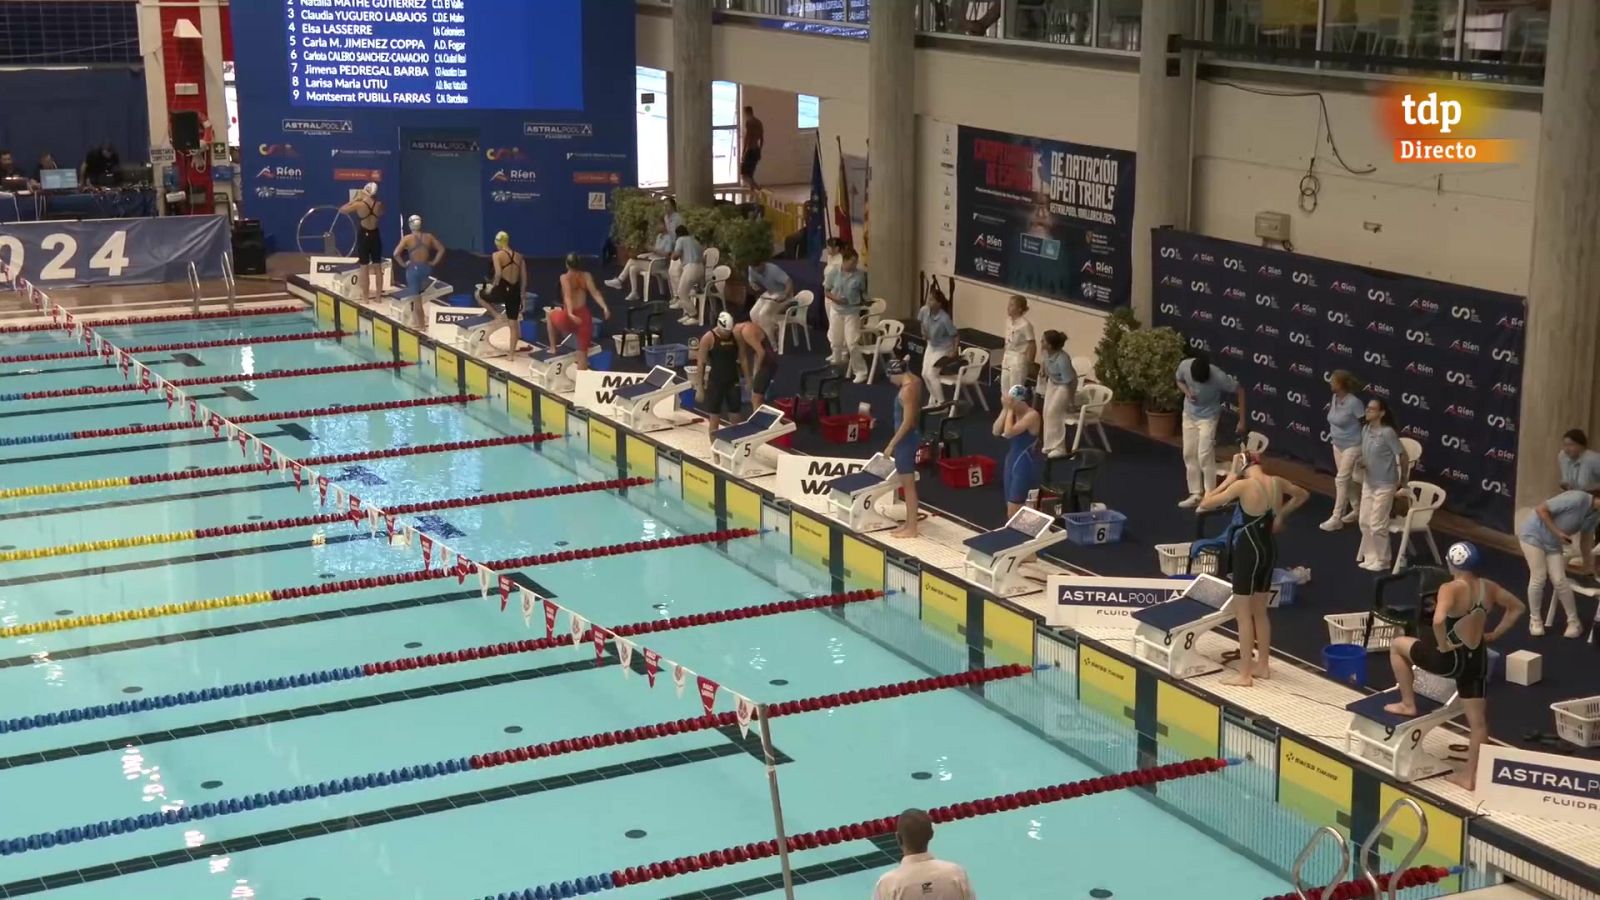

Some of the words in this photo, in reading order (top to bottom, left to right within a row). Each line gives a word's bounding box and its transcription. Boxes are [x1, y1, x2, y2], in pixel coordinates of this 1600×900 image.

[372, 0, 427, 8] GUTIERREZ
[288, 8, 295, 19] 3
[301, 10, 334, 21] Claudia
[335, 11, 383, 22] YUGUERO
[385, 12, 427, 22] LABAJOS
[288, 22, 296, 32] 4
[302, 23, 321, 34] Elsa
[323, 24, 373, 35] LASSERRE
[289, 35, 297, 46] 5
[302, 37, 327, 48] Carla
[329, 38, 342, 48] M.
[344, 39, 388, 49] JIMENEZ
[390, 39, 426, 50] COPPA
[290, 49, 298, 60] 6
[303, 50, 327, 61] Carlota
[328, 51, 355, 62] CALERO
[356, 52, 429, 63] SANCHEZ-CAMACHO
[291, 62, 298, 73] 7
[304, 64, 337, 75] Jimena
[339, 65, 392, 76] PEDREGAL
[394, 66, 429, 77] BARBA
[292, 76, 299, 86] 8
[305, 78, 332, 88] Larisa
[335, 79, 361, 89] Maria
[363, 79, 388, 90] UTIU
[293, 89, 300, 100] 9
[306, 91, 356, 102] Montserrat
[358, 92, 391, 103] PUBILL
[393, 93, 431, 104] FARRAS
[285, 120, 340, 130] ASTRALPOOL
[526, 125, 581, 135] ASTRALPOOL
[1051, 151, 1065, 176] DE
[1066, 153, 1118, 186] NATACIÓN
[1049, 175, 1077, 204] OPEN
[1078, 180, 1115, 210] TRIALS
[351, 274, 359, 286] 0
[479, 329, 486, 342] 2
[667, 355, 675, 367] 2
[555, 362, 563, 376] 3
[642, 400, 651, 413] 4
[849, 425, 857, 440] 4
[743, 442, 752, 458] 5
[970, 470, 980, 485] 5
[863, 494, 872, 510] 6
[1096, 527, 1106, 541] 6
[1006, 556, 1017, 573] 7
[1062, 589, 1161, 605] ASTRALPOOL
[1269, 590, 1280, 605] 7
[1097, 609, 1131, 617] FLUID
[1184, 632, 1195, 650] 8
[1384, 724, 1397, 742] 9
[1410, 728, 1422, 751] 9
[1294, 757, 1316, 771] SWISS
[1316, 766, 1339, 782] TIMING
[1497, 766, 1600, 793] ASTRALP
[1543, 795, 1600, 811] FLUIDR
